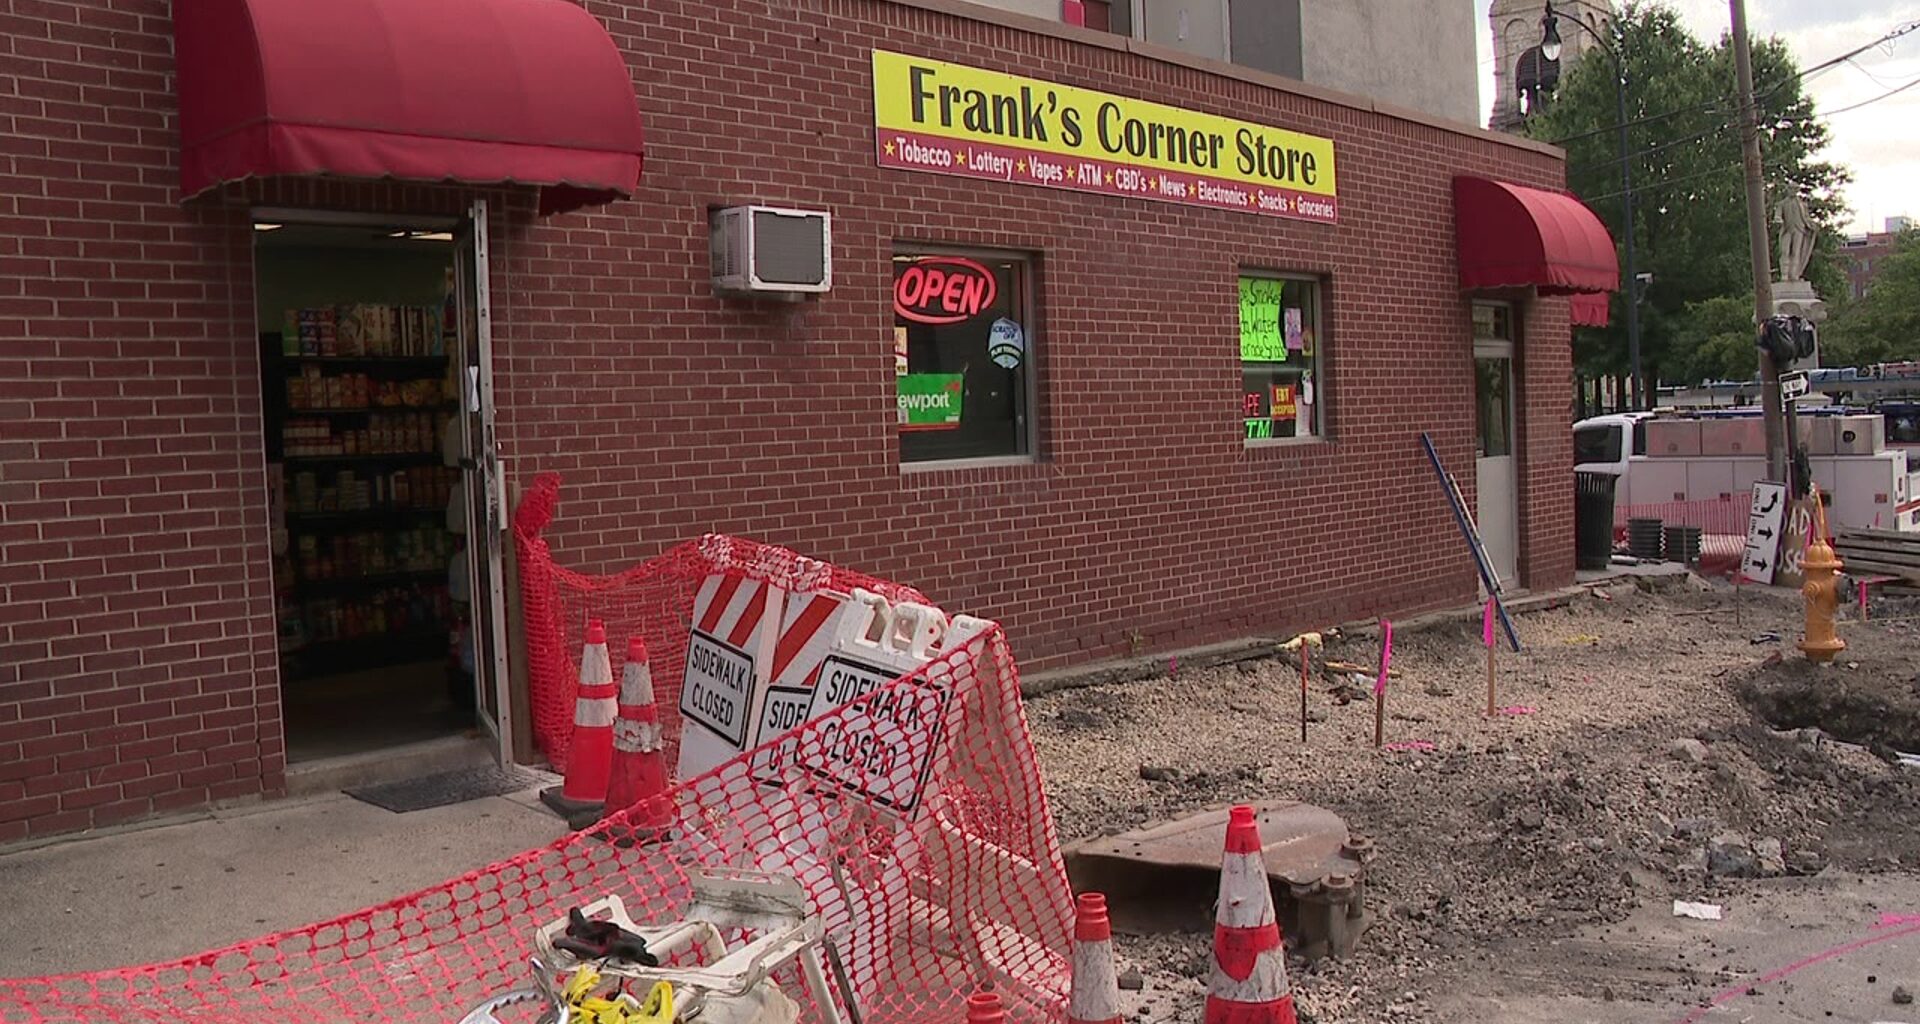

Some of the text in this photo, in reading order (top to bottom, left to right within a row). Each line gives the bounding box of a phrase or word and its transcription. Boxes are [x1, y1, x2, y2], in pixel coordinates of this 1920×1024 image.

[910, 65, 1316, 185] Frank's Corner Store
[896, 137, 1334, 218] Tobacco Lottery Vapes ATM CBD's News Electronics Snacks Groceries
[899, 266, 985, 315] OPEN
[897, 392, 950, 412] ewport
[1246, 420, 1271, 438] TM
[1749, 518, 1757, 542] ONLY
[1743, 549, 1752, 572] ONLY
[692, 643, 746, 694] SIDEWALK
[692, 682, 734, 727] CLOSED
[769, 700, 807, 730] SIDE
[826, 670, 924, 730] SIDEWALK
